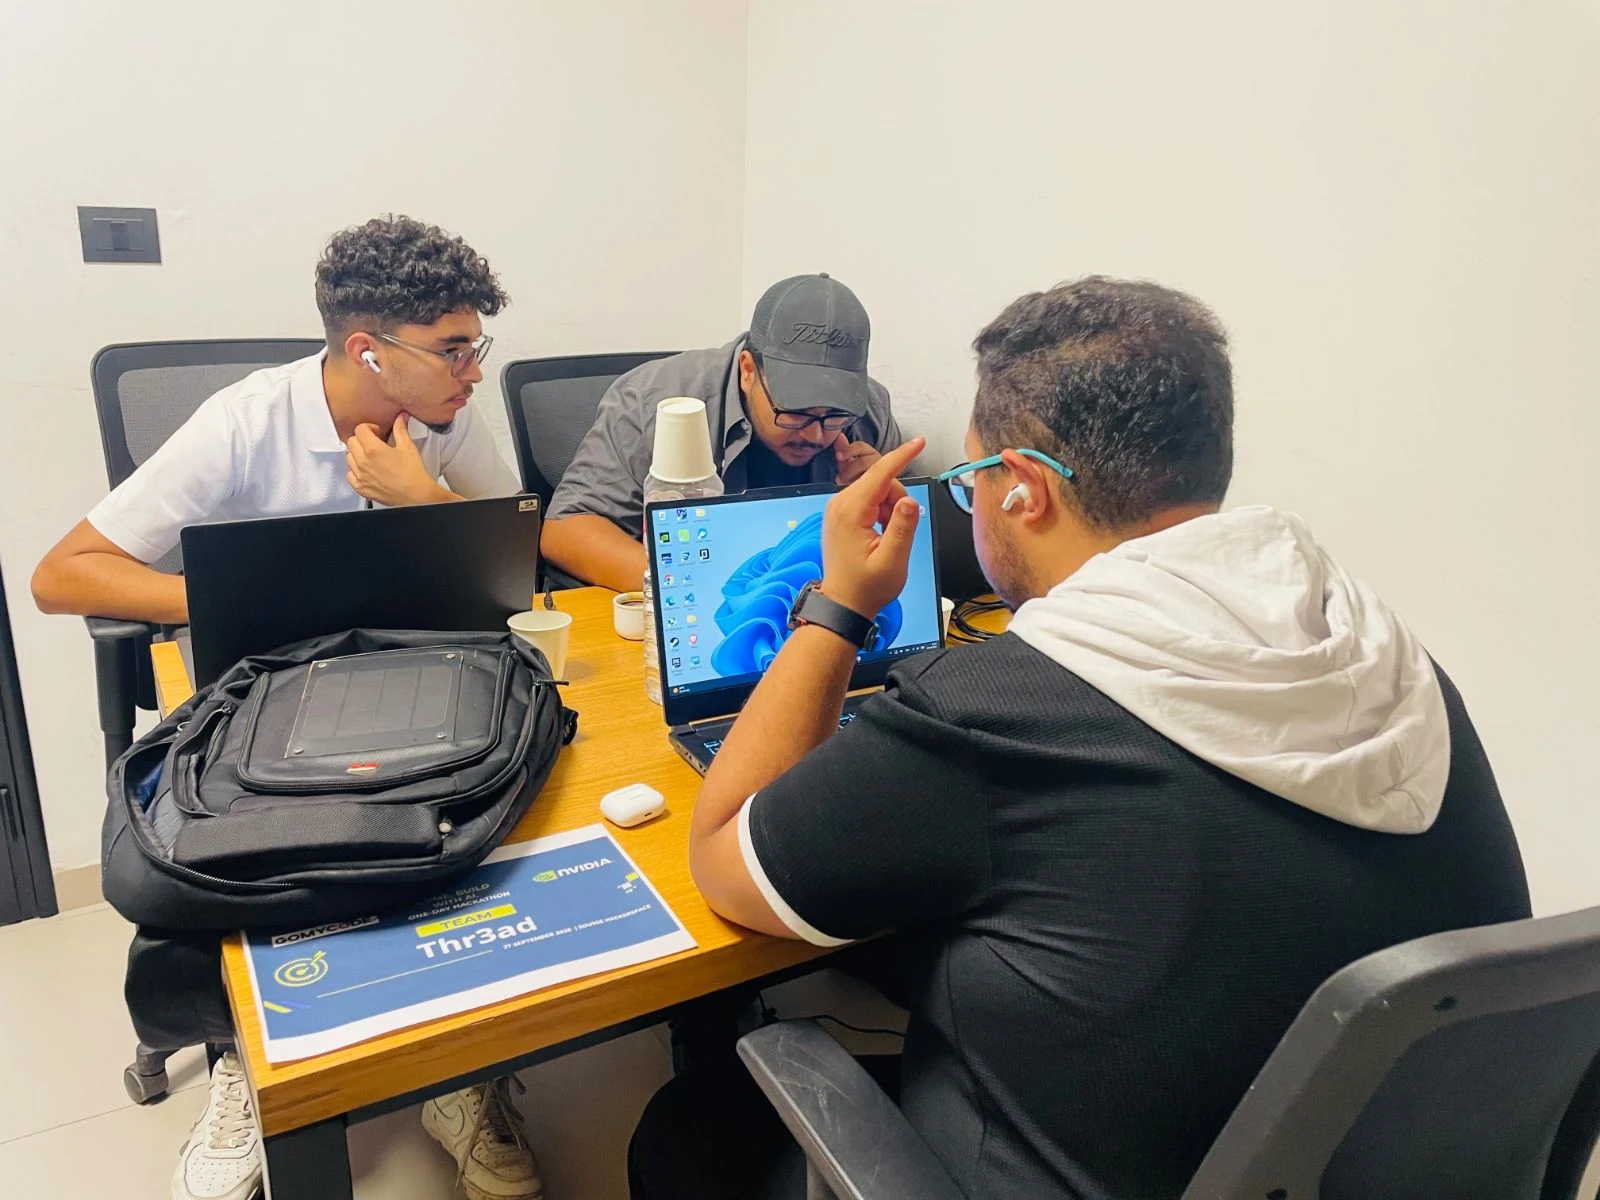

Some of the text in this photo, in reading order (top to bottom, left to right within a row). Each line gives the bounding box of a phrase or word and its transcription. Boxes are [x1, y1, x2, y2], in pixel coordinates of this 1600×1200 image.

[556, 858, 613, 877] NVIDIA
[456, 883, 490, 896] BUILD
[408, 890, 511, 921] ONE-DAY HACKATHON
[440, 911, 493, 930] TEAM
[513, 932, 555, 947] SEPTEMBER
[604, 903, 652, 923] HACKERSPACE
[415, 916, 538, 959] Thr3ad
